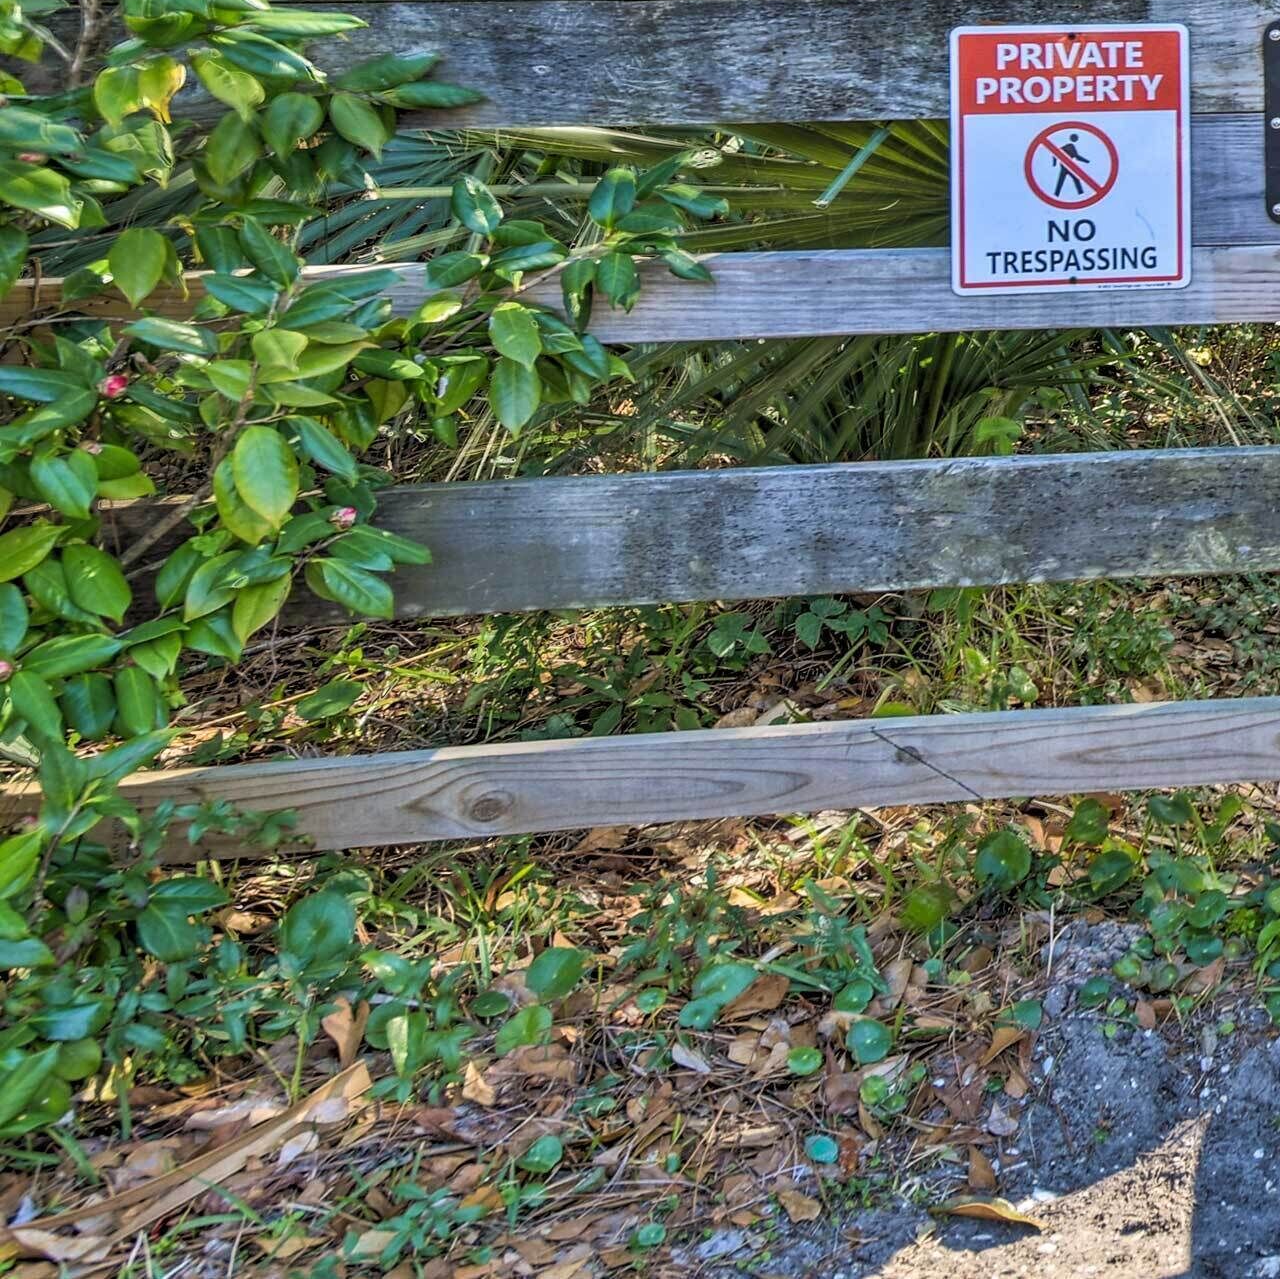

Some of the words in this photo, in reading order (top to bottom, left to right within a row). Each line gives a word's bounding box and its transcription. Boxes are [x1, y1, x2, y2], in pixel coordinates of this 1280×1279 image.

[996, 41, 1144, 71] PRIVATE
[976, 74, 1164, 105] PROPERTY
[1047, 218, 1096, 243] NO
[986, 246, 1157, 275] TRESPASSING
